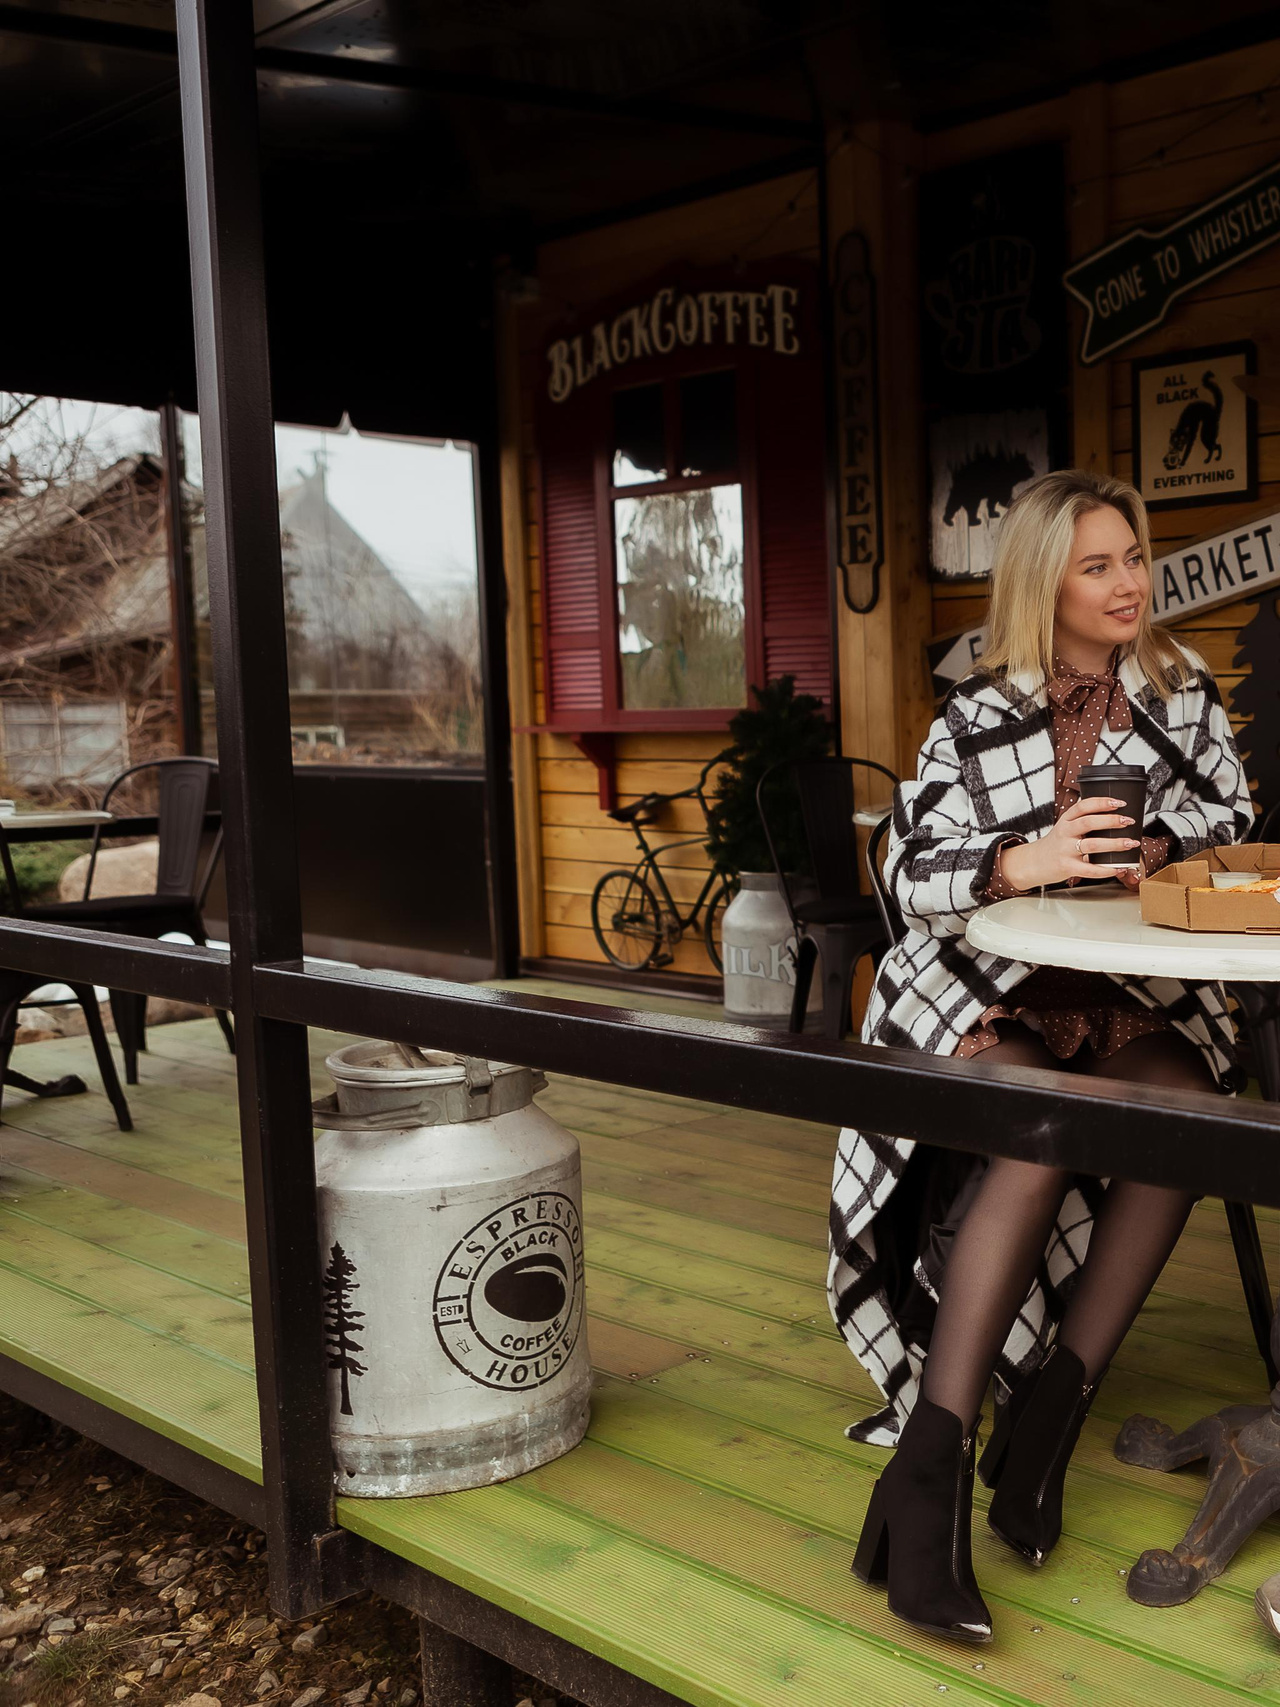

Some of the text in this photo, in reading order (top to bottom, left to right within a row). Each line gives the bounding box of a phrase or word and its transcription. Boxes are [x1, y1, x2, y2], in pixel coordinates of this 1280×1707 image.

[1095, 263, 1147, 319] GONE
[1153, 244, 1181, 286] TO
[1156, 387, 1199, 404] BLACK
[1163, 374, 1187, 388] ALL
[841, 274, 873, 565] COFFEE
[1153, 469, 1235, 489] EVERYTHING
[448, 1200, 579, 1280] ESPRESSO
[501, 1231, 559, 1262] BLACK
[440, 1304, 464, 1317] ESTD
[500, 1317, 562, 1351] COFFEE
[485, 1333, 573, 1384] HOUSE
